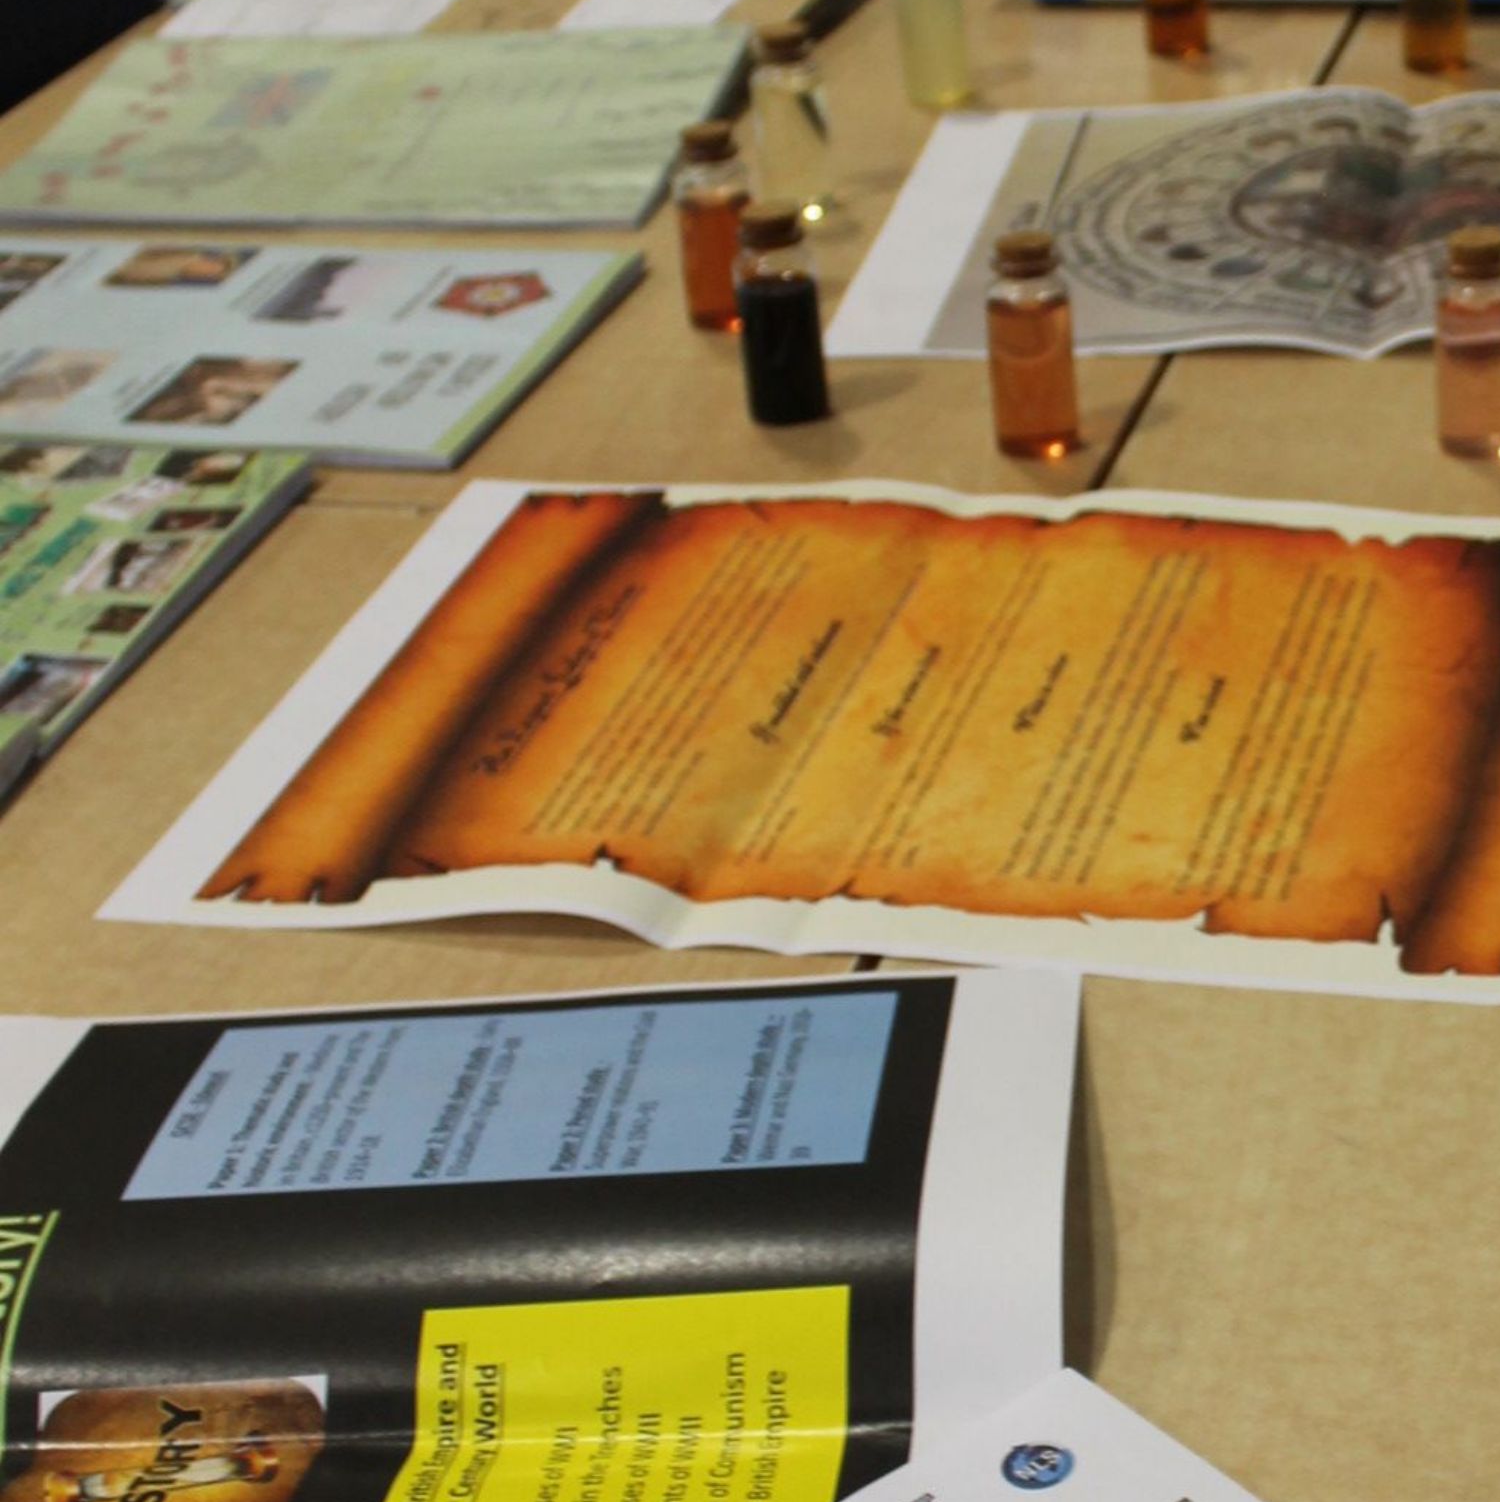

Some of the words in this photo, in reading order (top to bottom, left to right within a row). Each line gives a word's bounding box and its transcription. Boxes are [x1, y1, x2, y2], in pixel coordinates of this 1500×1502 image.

[436, 1343, 459, 1390] and
[423, 1399, 459, 1467] Empire
[449, 1448, 498, 1497] Century
[475, 1364, 498, 1444] World
[588, 1366, 622, 1461] Trenches
[709, 1352, 746, 1480] Communism
[759, 1370, 791, 1454] Empire
[549, 1426, 579, 1464] WWI
[633, 1413, 662, 1461] WWII
[673, 1416, 703, 1461] WWII
[542, 1466, 564, 1481] of
[580, 1465, 608, 1487] the
[628, 1464, 650, 1479] of
[668, 1465, 692, 1481] of
[747, 1454, 778, 1501] British
[1013, 1450, 1057, 1481] NLS
[573, 1489, 598, 1502] in
[704, 1482, 730, 1498] of
